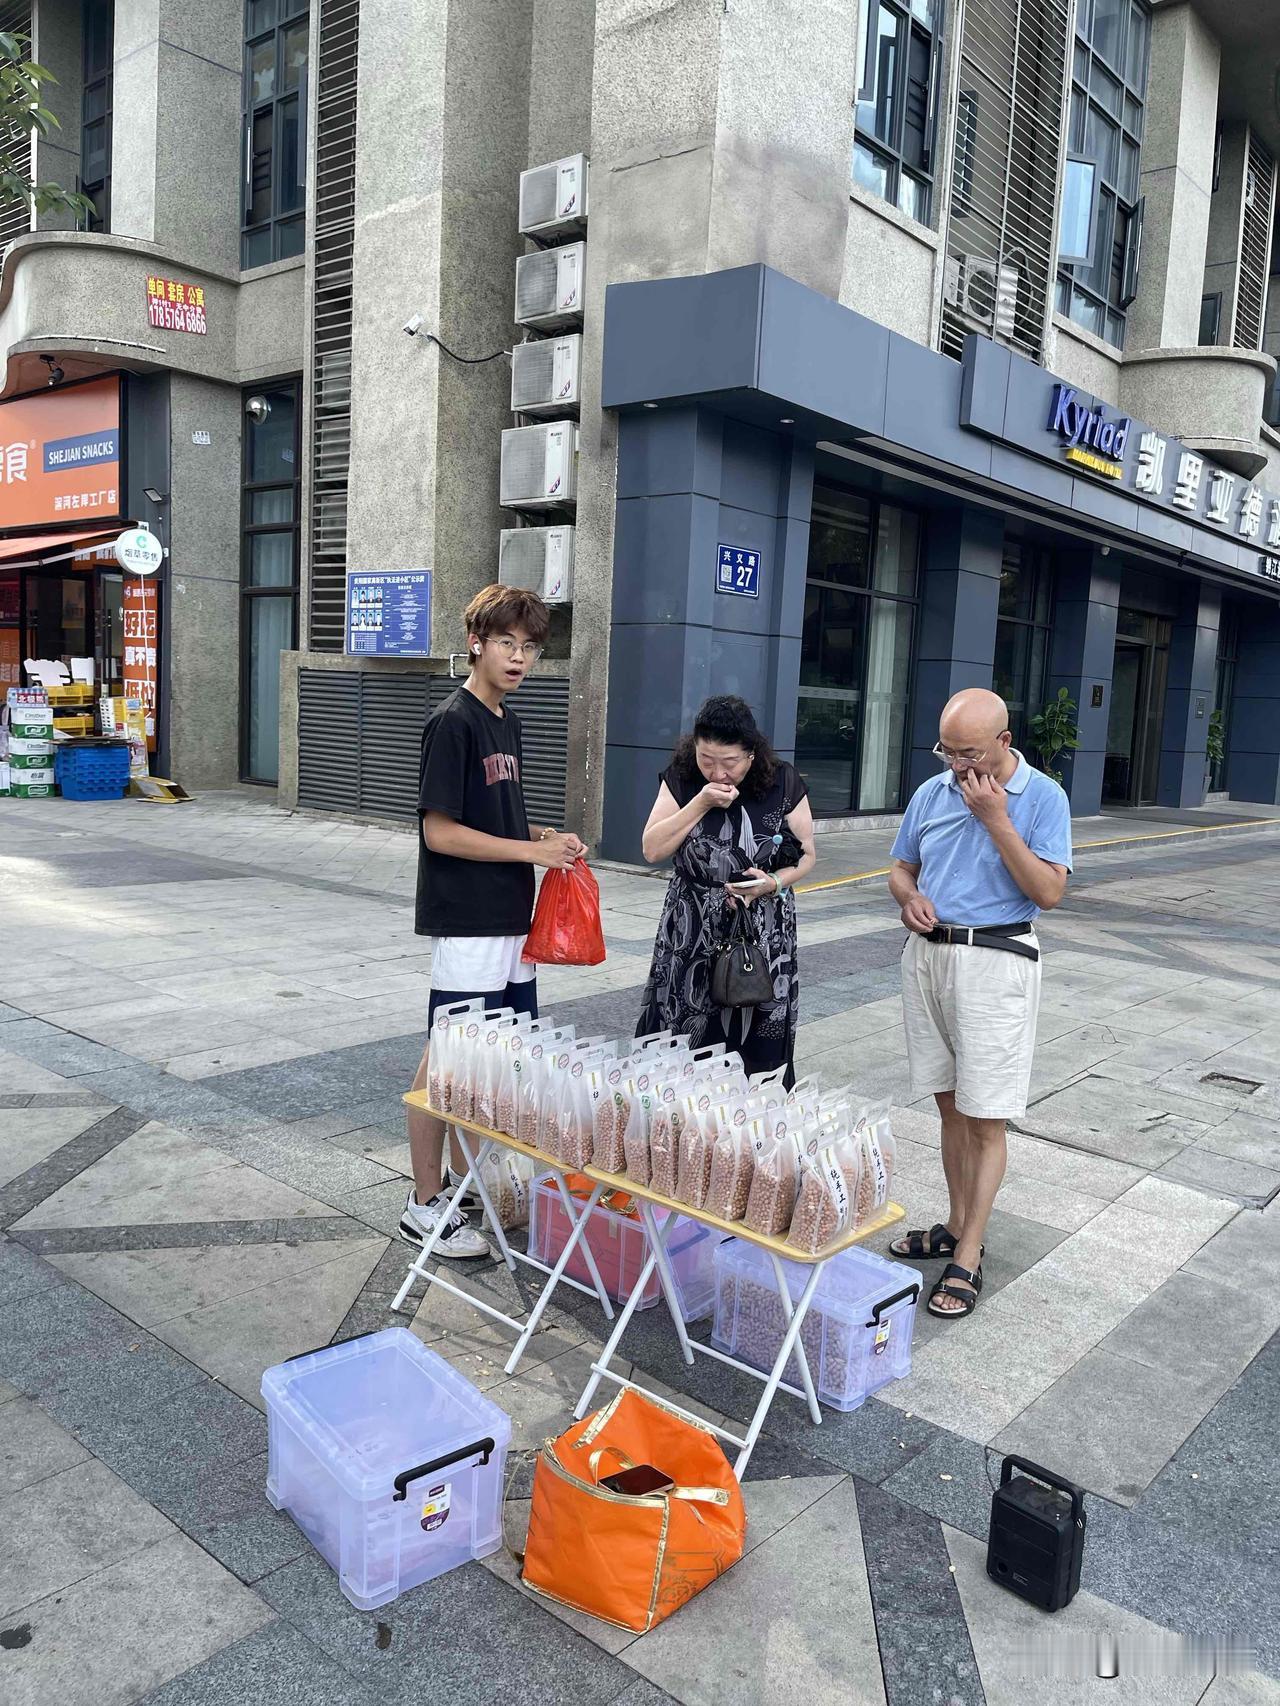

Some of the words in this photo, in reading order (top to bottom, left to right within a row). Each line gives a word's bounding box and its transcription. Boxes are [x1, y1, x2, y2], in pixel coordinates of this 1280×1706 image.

[148, 278, 165, 299] 单间
[168, 282, 184, 303] 套房
[188, 287, 204, 307] 公寓
[1048, 384, 1132, 462] Kyriad
[0, 442, 28, 484] 食
[48, 448, 81, 465] SHEJIAN
[82, 441, 114, 459] SNACKS
[736, 565, 753, 588] 27
